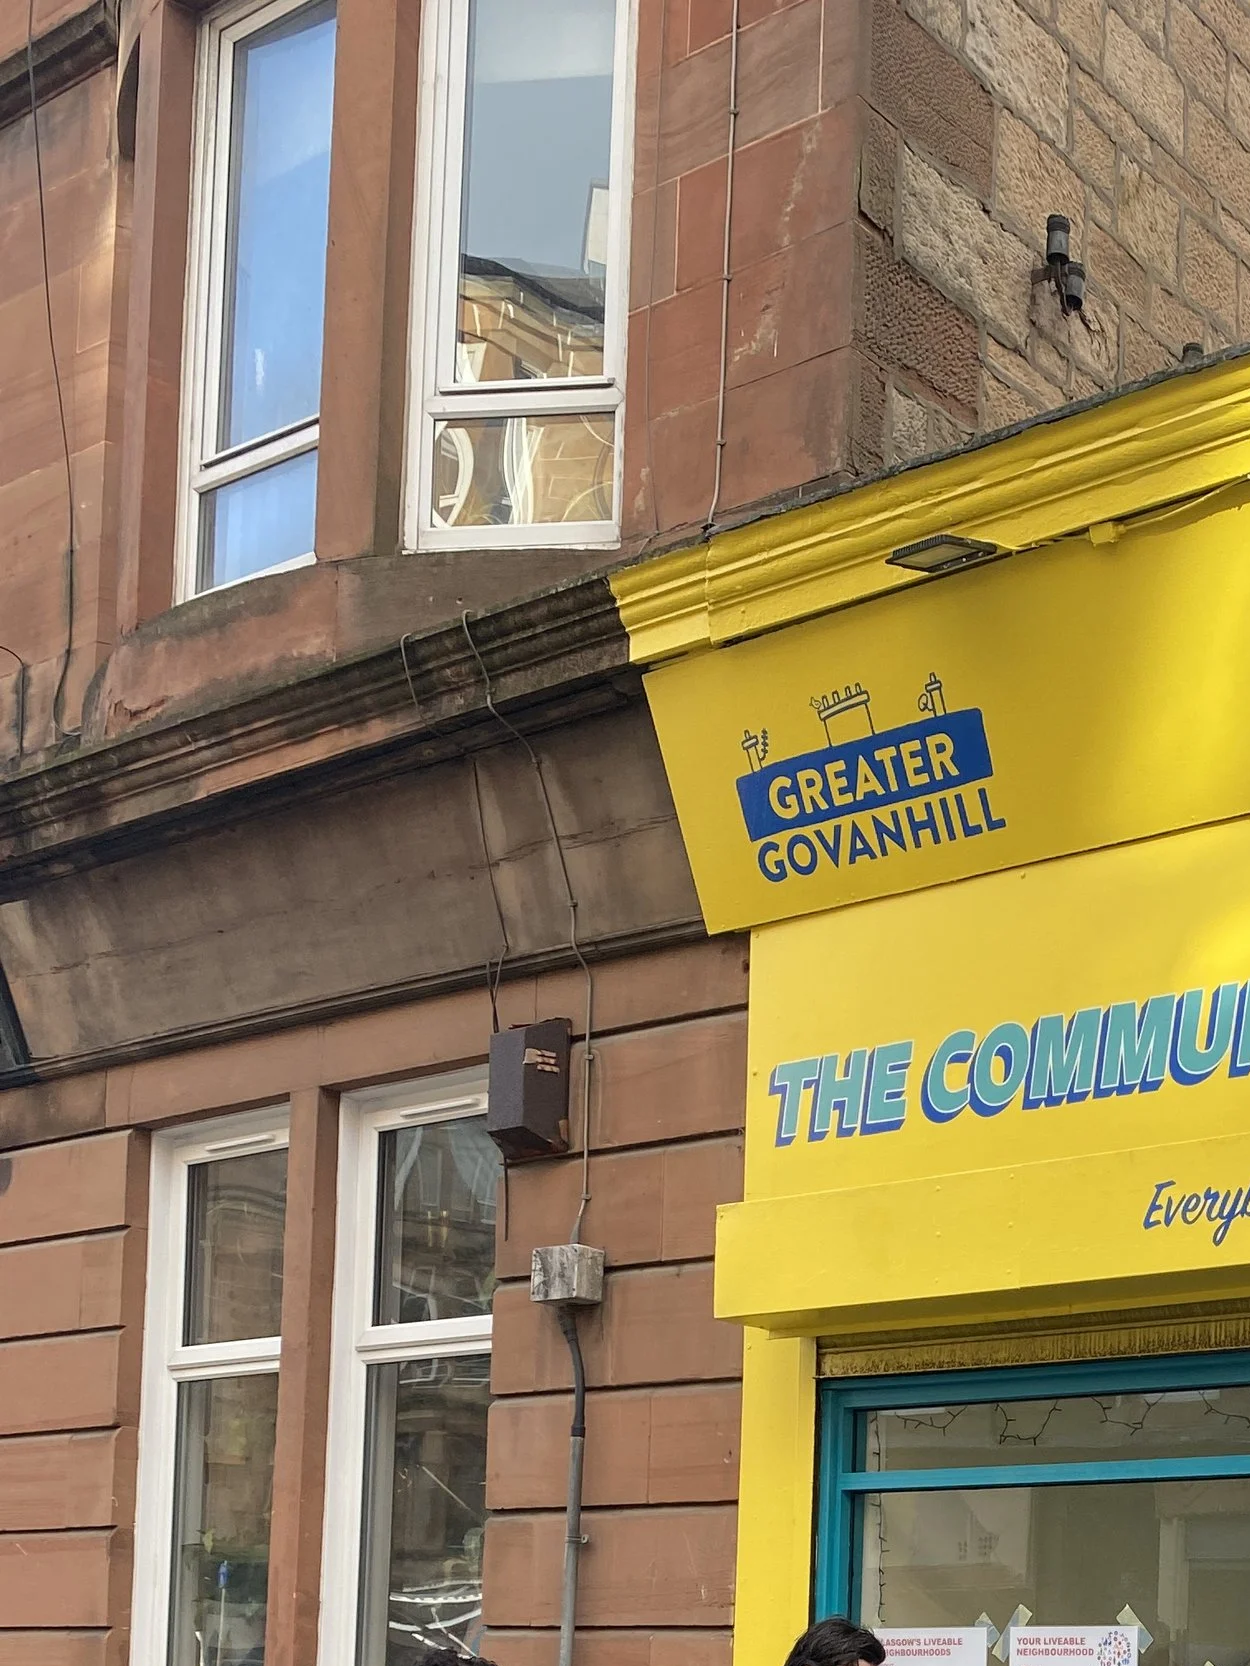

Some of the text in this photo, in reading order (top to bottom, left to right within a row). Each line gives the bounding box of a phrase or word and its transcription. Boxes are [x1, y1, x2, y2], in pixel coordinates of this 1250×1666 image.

[767, 732, 960, 820] GREATER
[757, 789, 1006, 883] GOVANHILL
[769, 1039, 913, 1147] THE
[923, 1638, 963, 1646] LIVEABLE
[1017, 1637, 1086, 1645] YOUR LIVEABLE
[1017, 1648, 1094, 1656] NEIGHBOURHOOD
